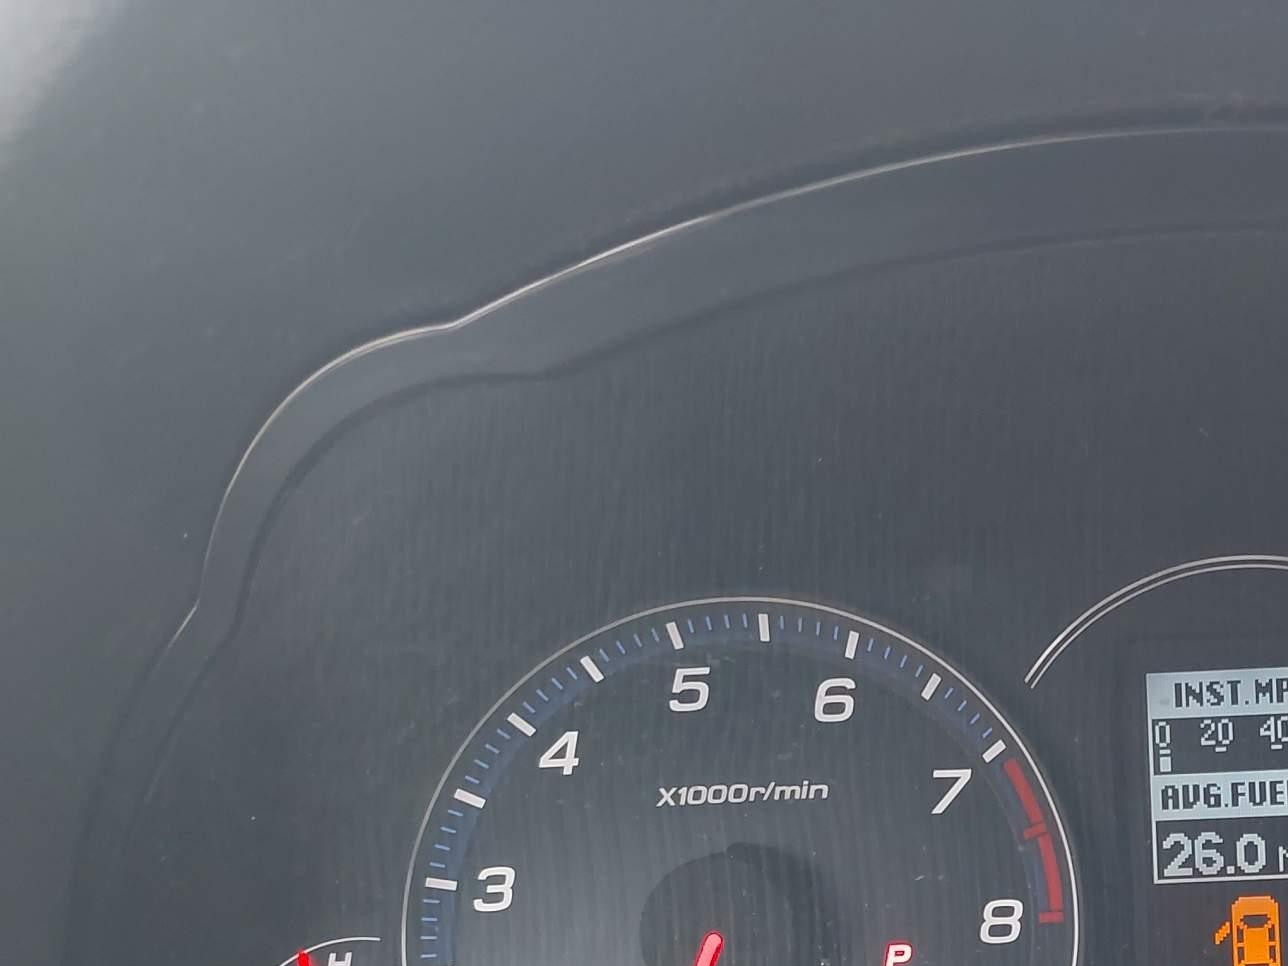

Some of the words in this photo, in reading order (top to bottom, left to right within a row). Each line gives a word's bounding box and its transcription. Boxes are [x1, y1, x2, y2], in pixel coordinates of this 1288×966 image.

[669, 667, 711, 712] 5
[814, 678, 856, 722] 6
[539, 731, 580, 775] 4
[1154, 721, 1171, 748] 0
[1200, 719, 1234, 746] 20
[656, 780, 829, 807] X1000r/min
[931, 768, 972, 813] 7
[1162, 832, 1266, 876] 26.0
[473, 866, 517, 911] 3
[979, 899, 1023, 944] 8
